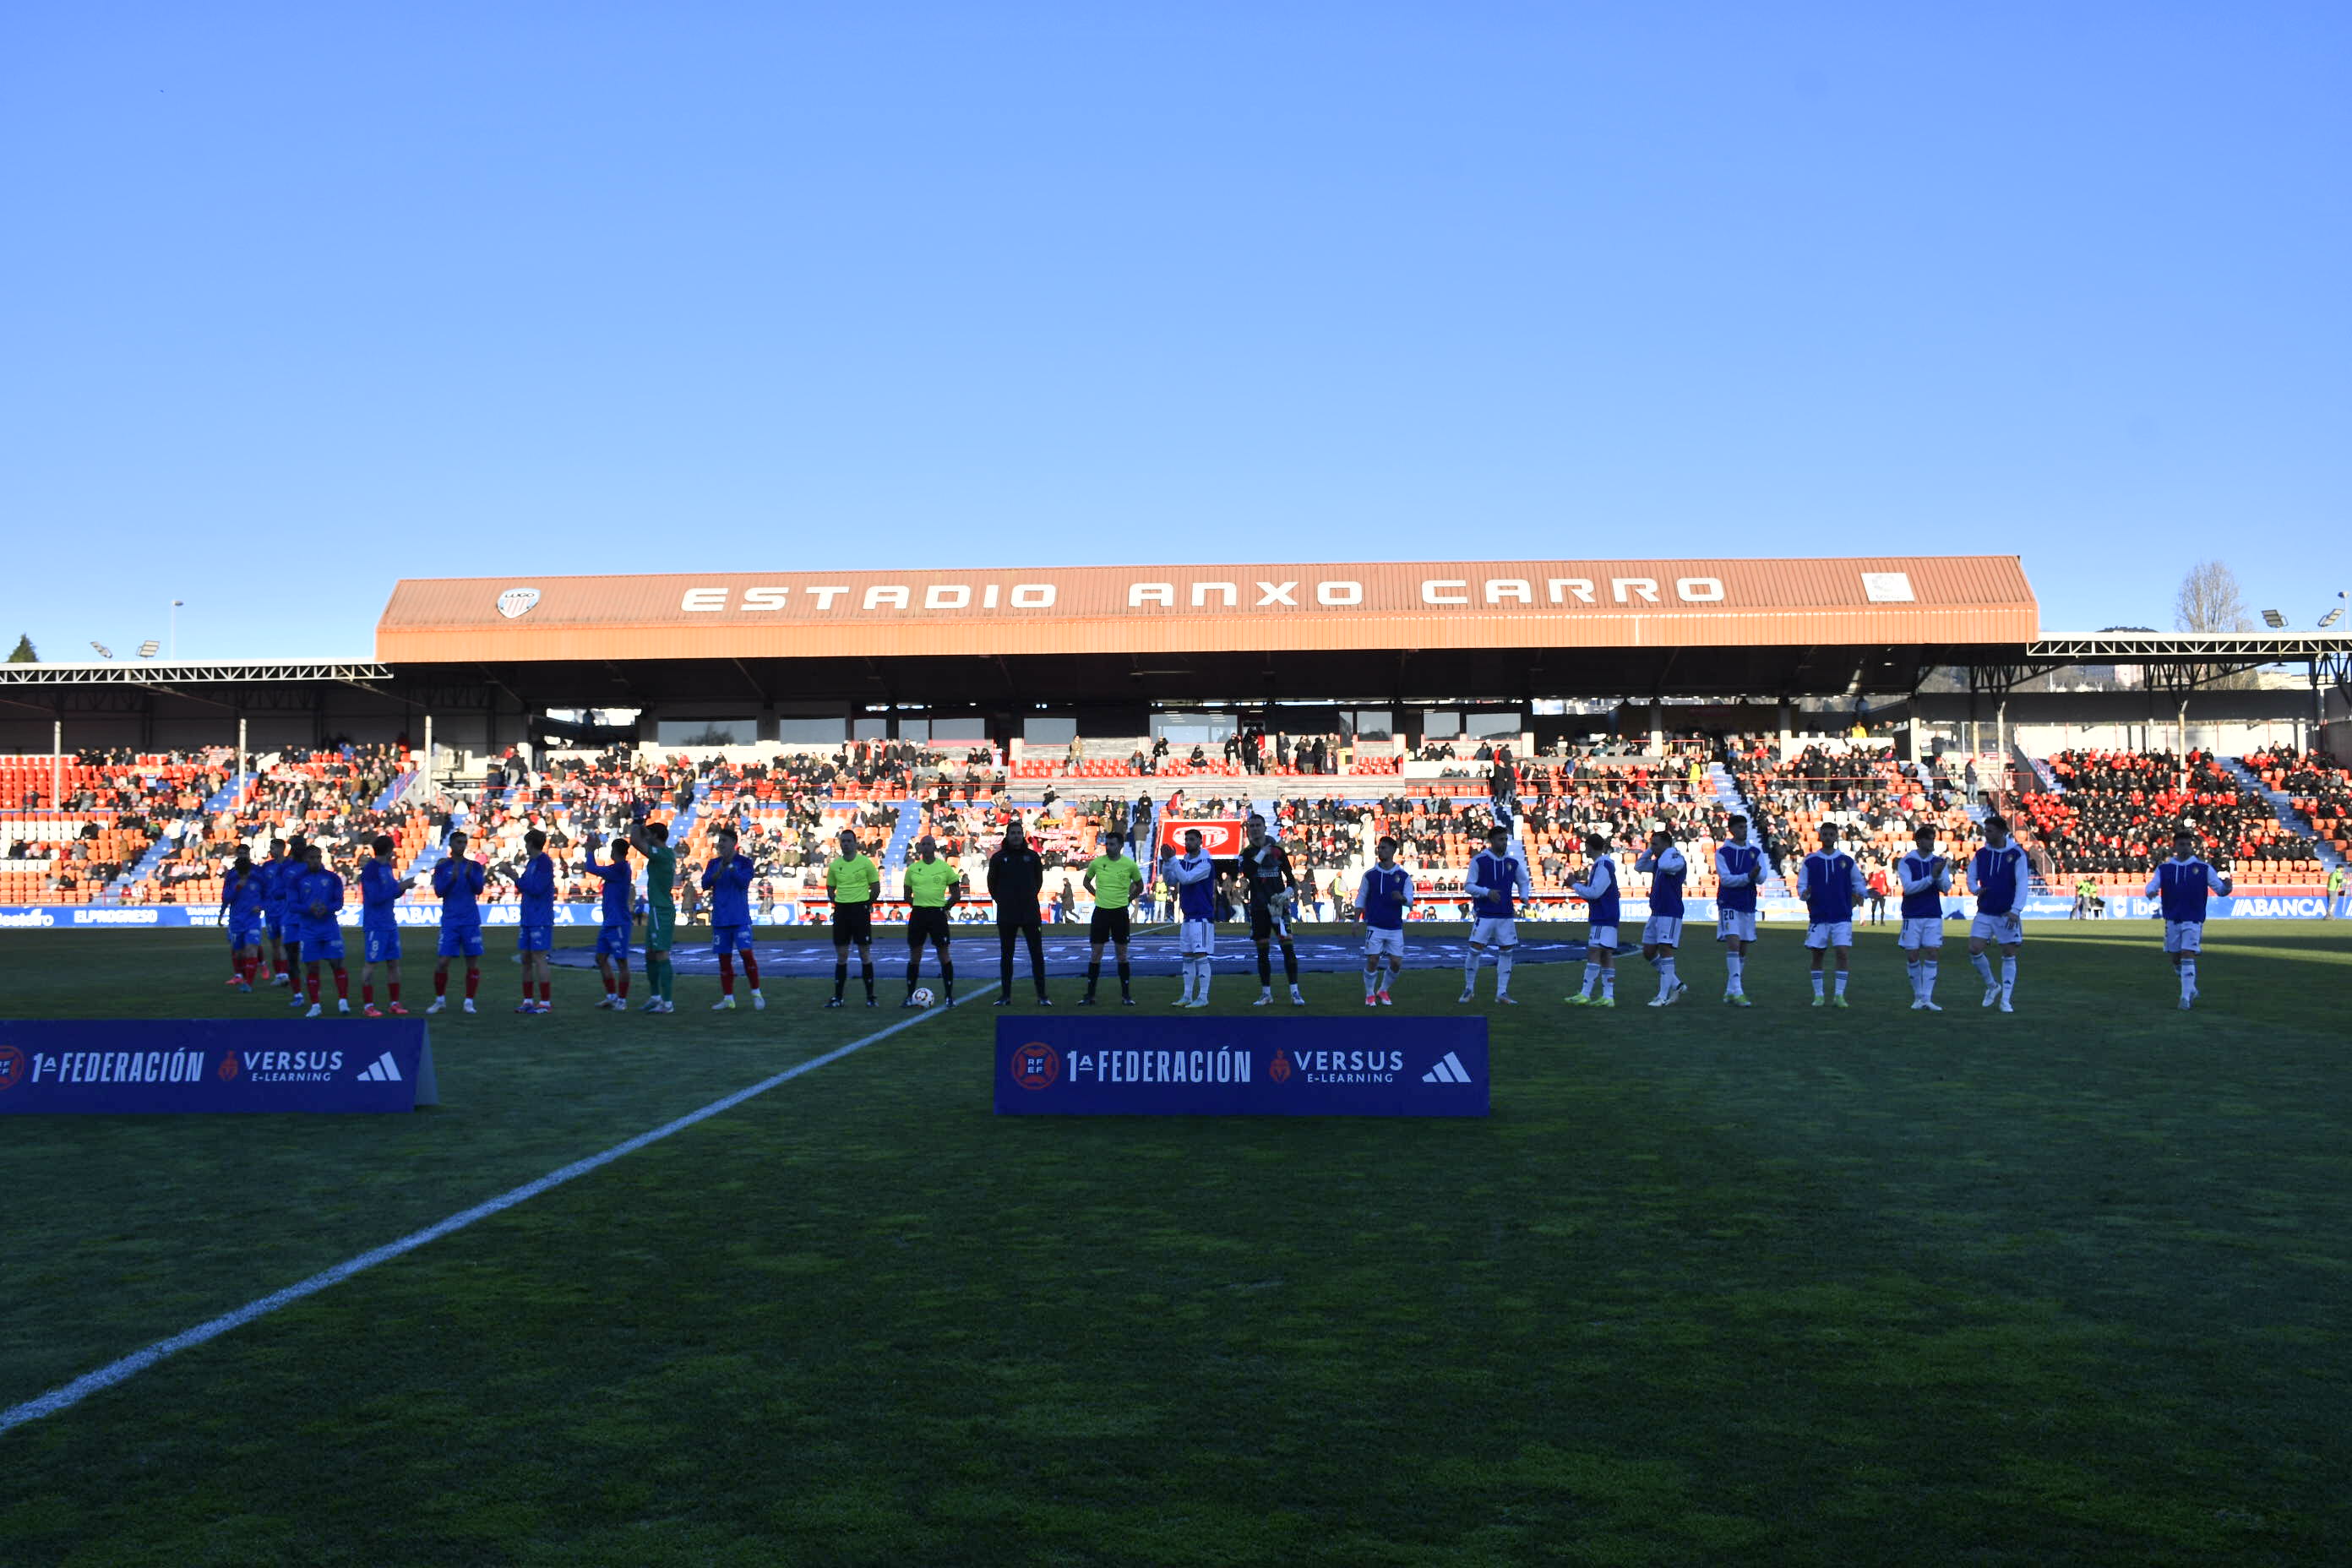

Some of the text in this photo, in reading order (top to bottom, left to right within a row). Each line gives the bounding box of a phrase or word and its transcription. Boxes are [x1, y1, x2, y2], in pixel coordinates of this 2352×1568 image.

[681, 577, 1724, 612] ESTADIO ANXO CARRO
[394, 905, 443, 923] ABAN
[1723, 910, 1734, 920] 20
[2231, 899, 2326, 917] ABANCA
[59, 1047, 204, 1083] FEDERACIÓN
[244, 1051, 343, 1070] VERSUS
[1098, 1045, 1250, 1083] FEDERACIÓN
[1294, 1051, 1404, 1071] VERSUS
[252, 1072, 331, 1082] E-LEARNING
[1307, 1073, 1394, 1083] E-LEARNING
